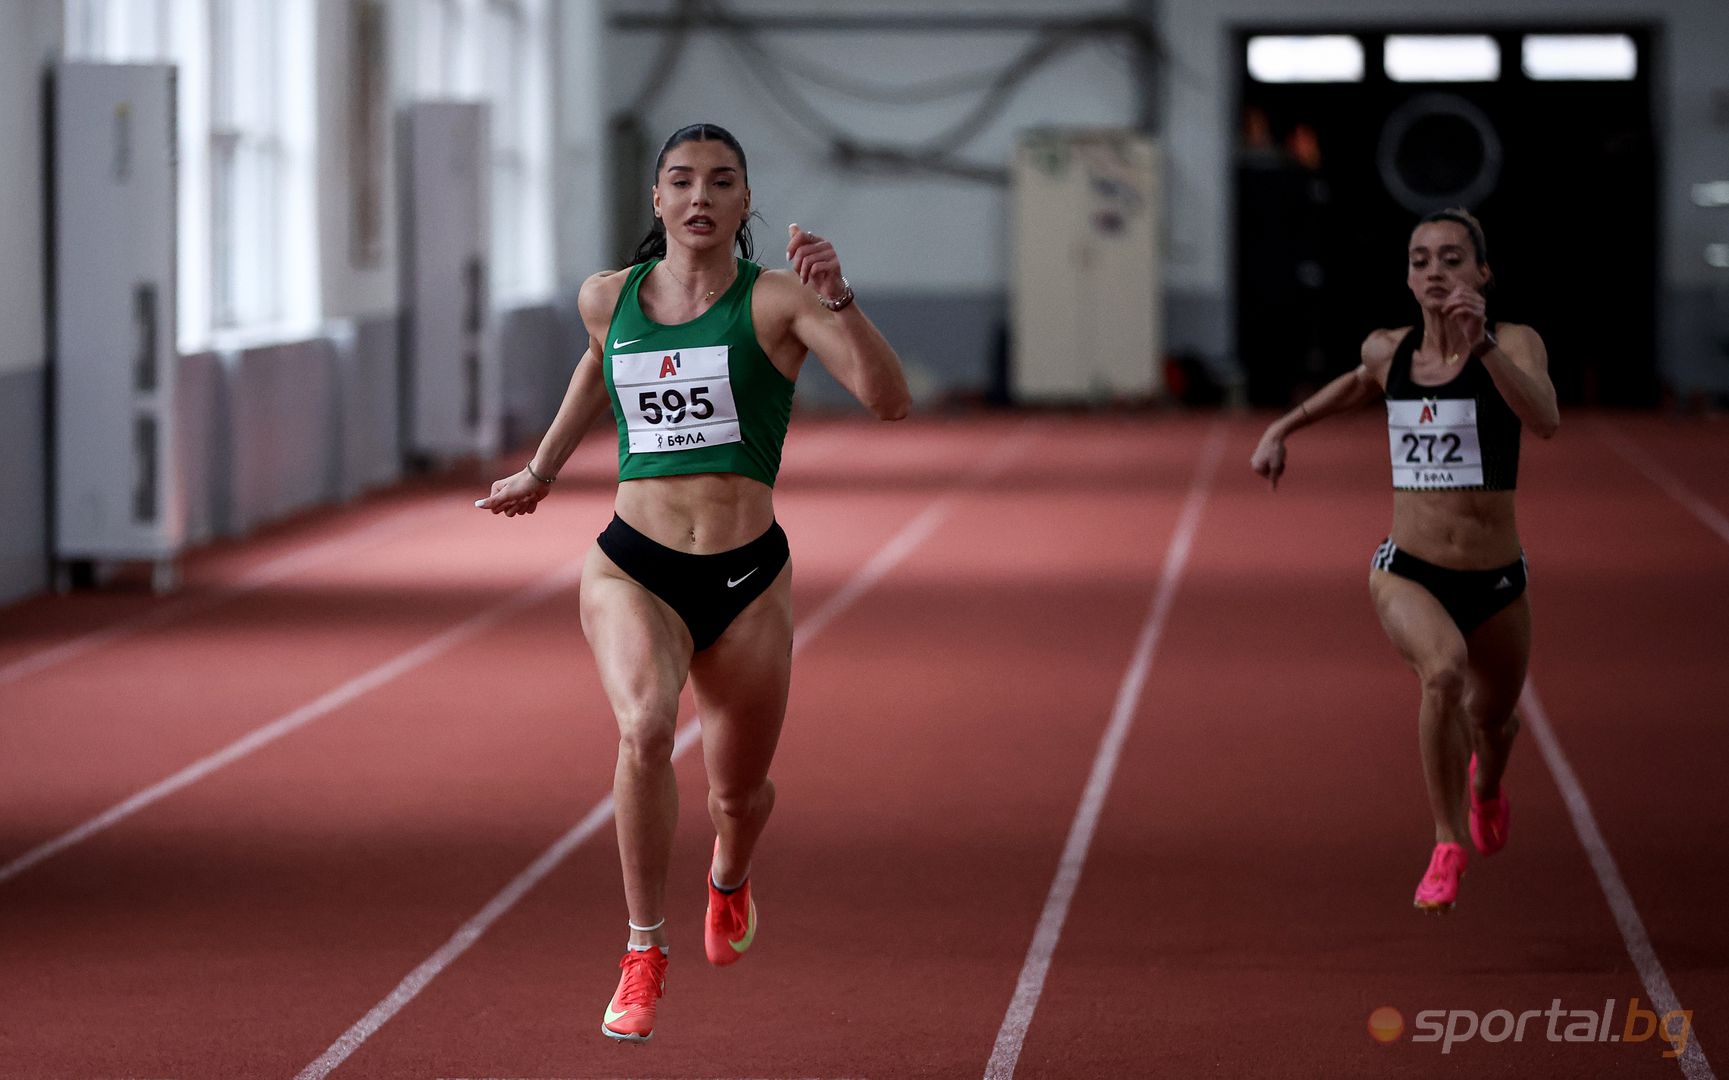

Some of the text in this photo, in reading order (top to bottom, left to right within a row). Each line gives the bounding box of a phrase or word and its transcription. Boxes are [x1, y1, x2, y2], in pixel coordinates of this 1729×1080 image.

[659, 352, 681, 378] A1
[639, 386, 715, 425] 595
[668, 432, 706, 447] БФЛА
[1402, 433, 1463, 463] 272
